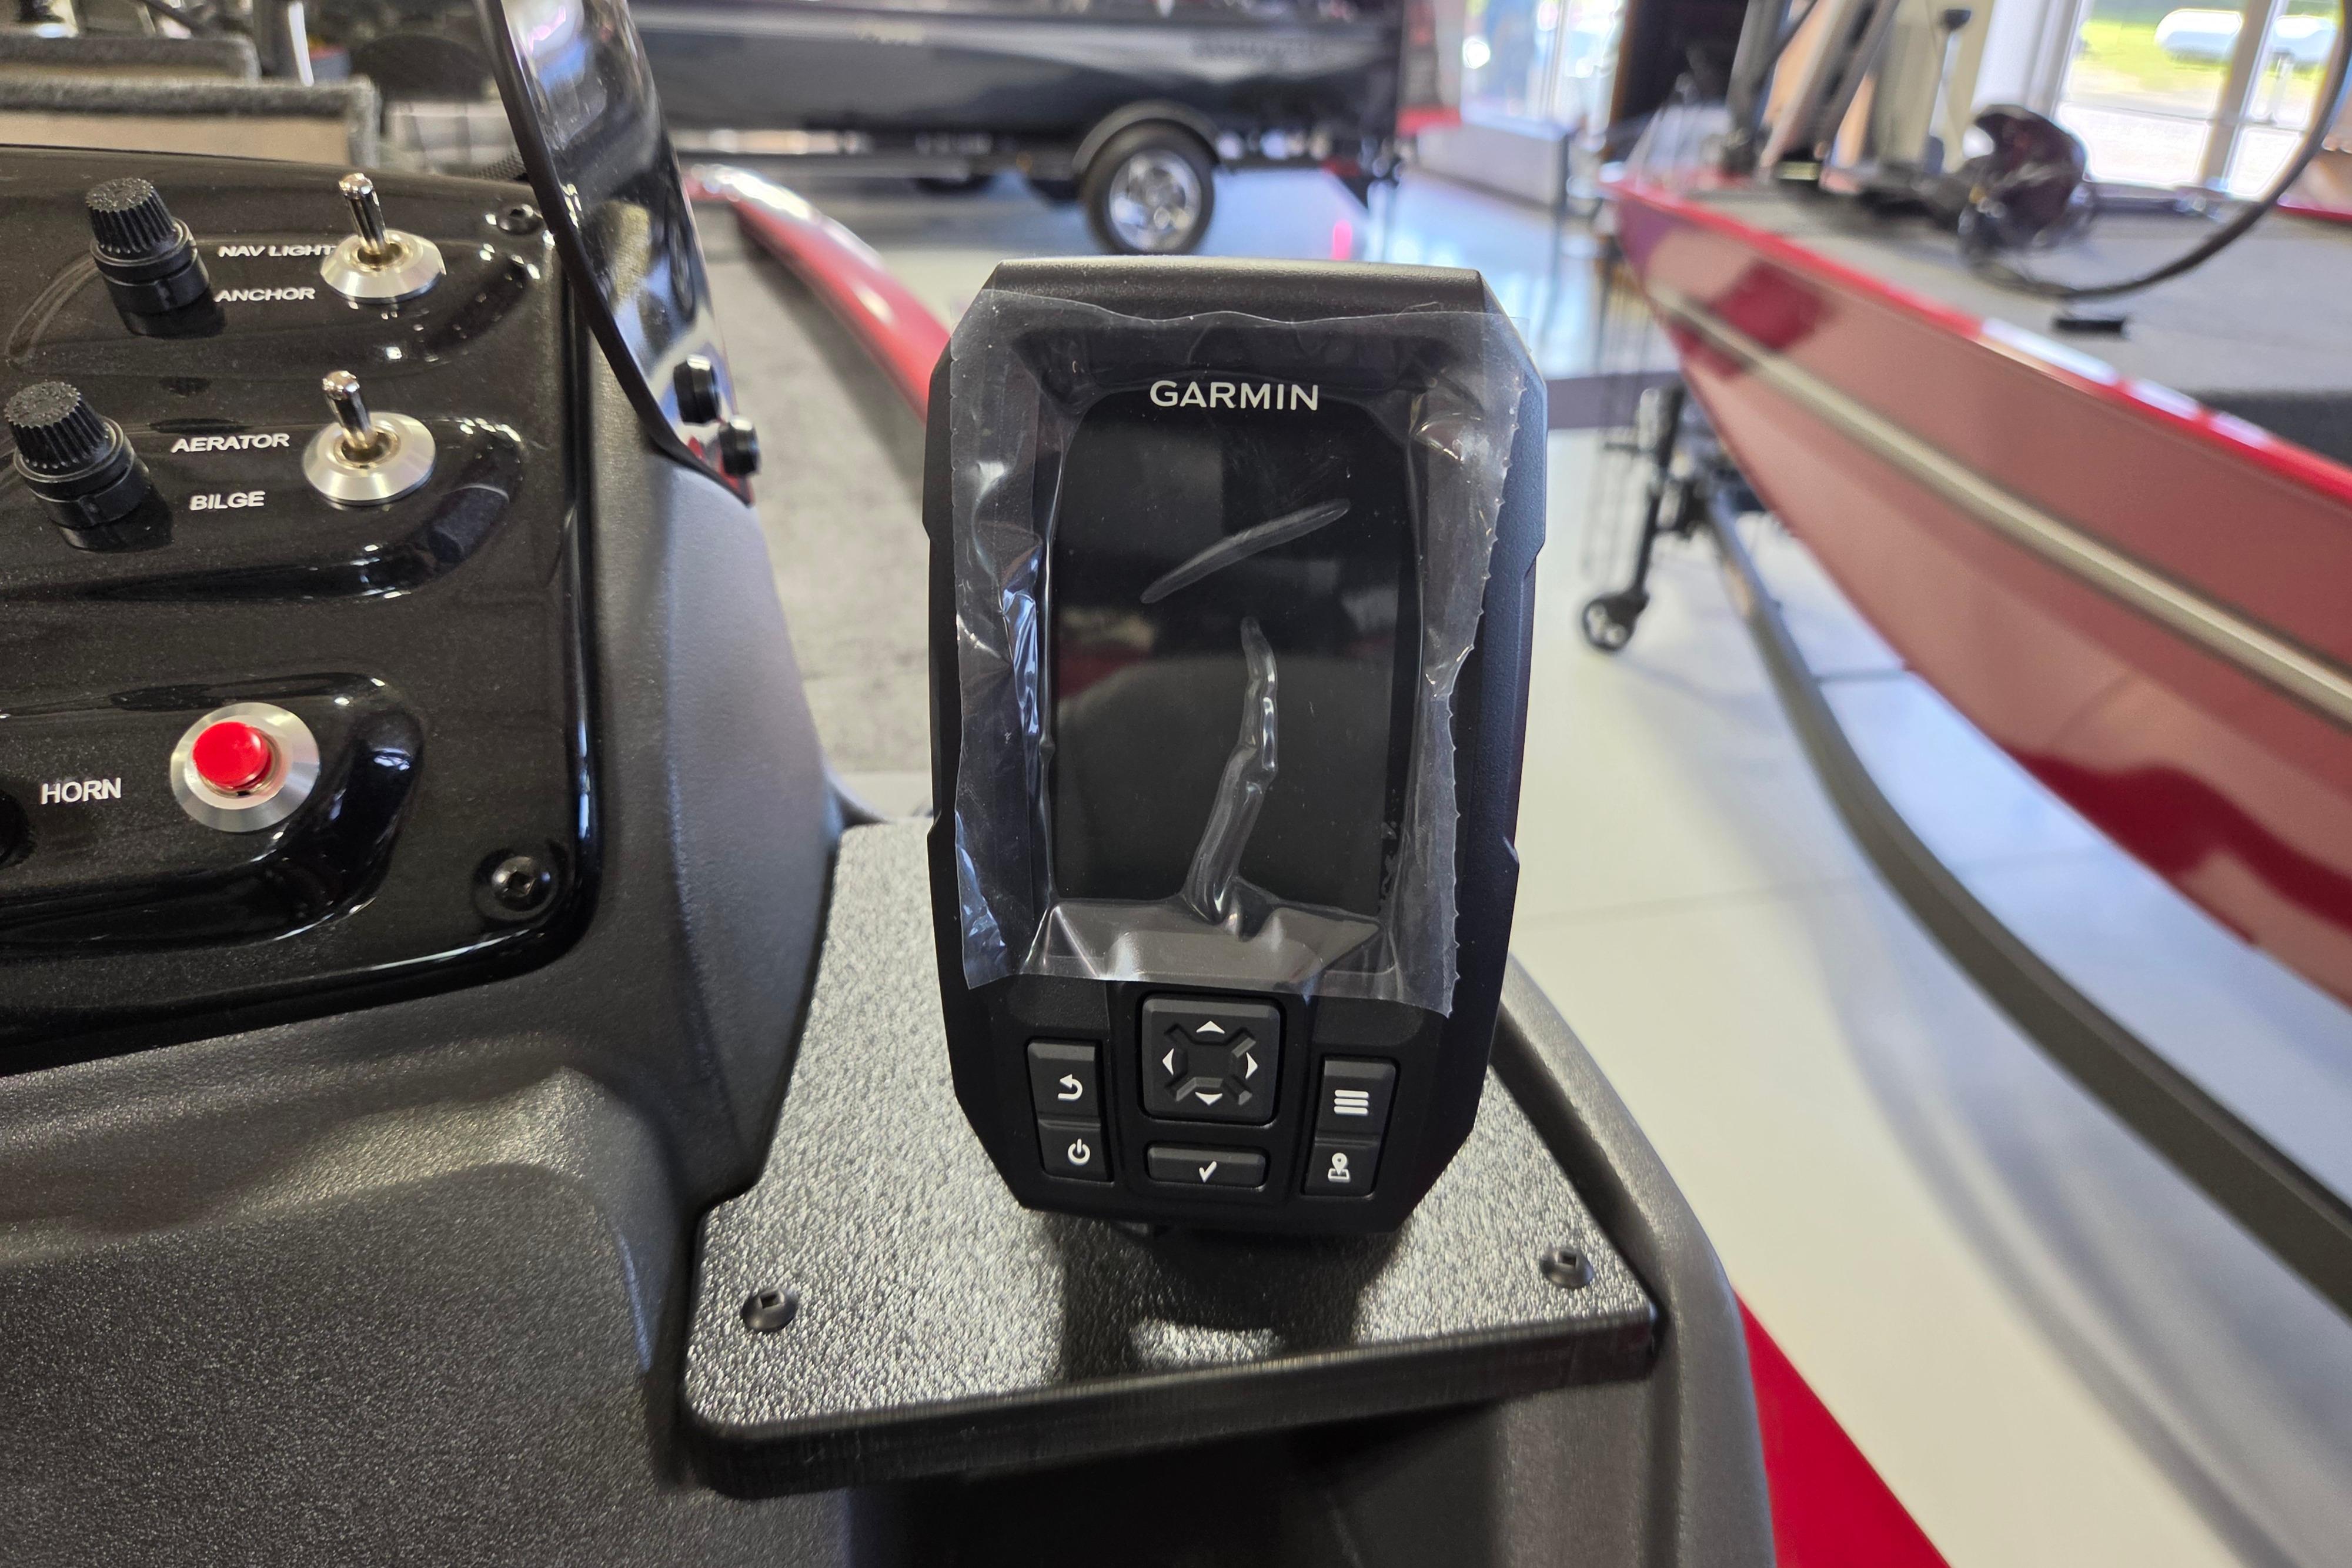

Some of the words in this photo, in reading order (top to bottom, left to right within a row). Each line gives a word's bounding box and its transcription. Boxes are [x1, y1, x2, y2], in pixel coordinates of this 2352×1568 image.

[217, 245, 265, 257] NAV
[213, 286, 316, 302] ANCHOR
[1150, 380, 1318, 411] GARMIN
[171, 433, 290, 453] AERATOR
[189, 490, 265, 511] BILGE
[41, 777, 122, 805] HORN
